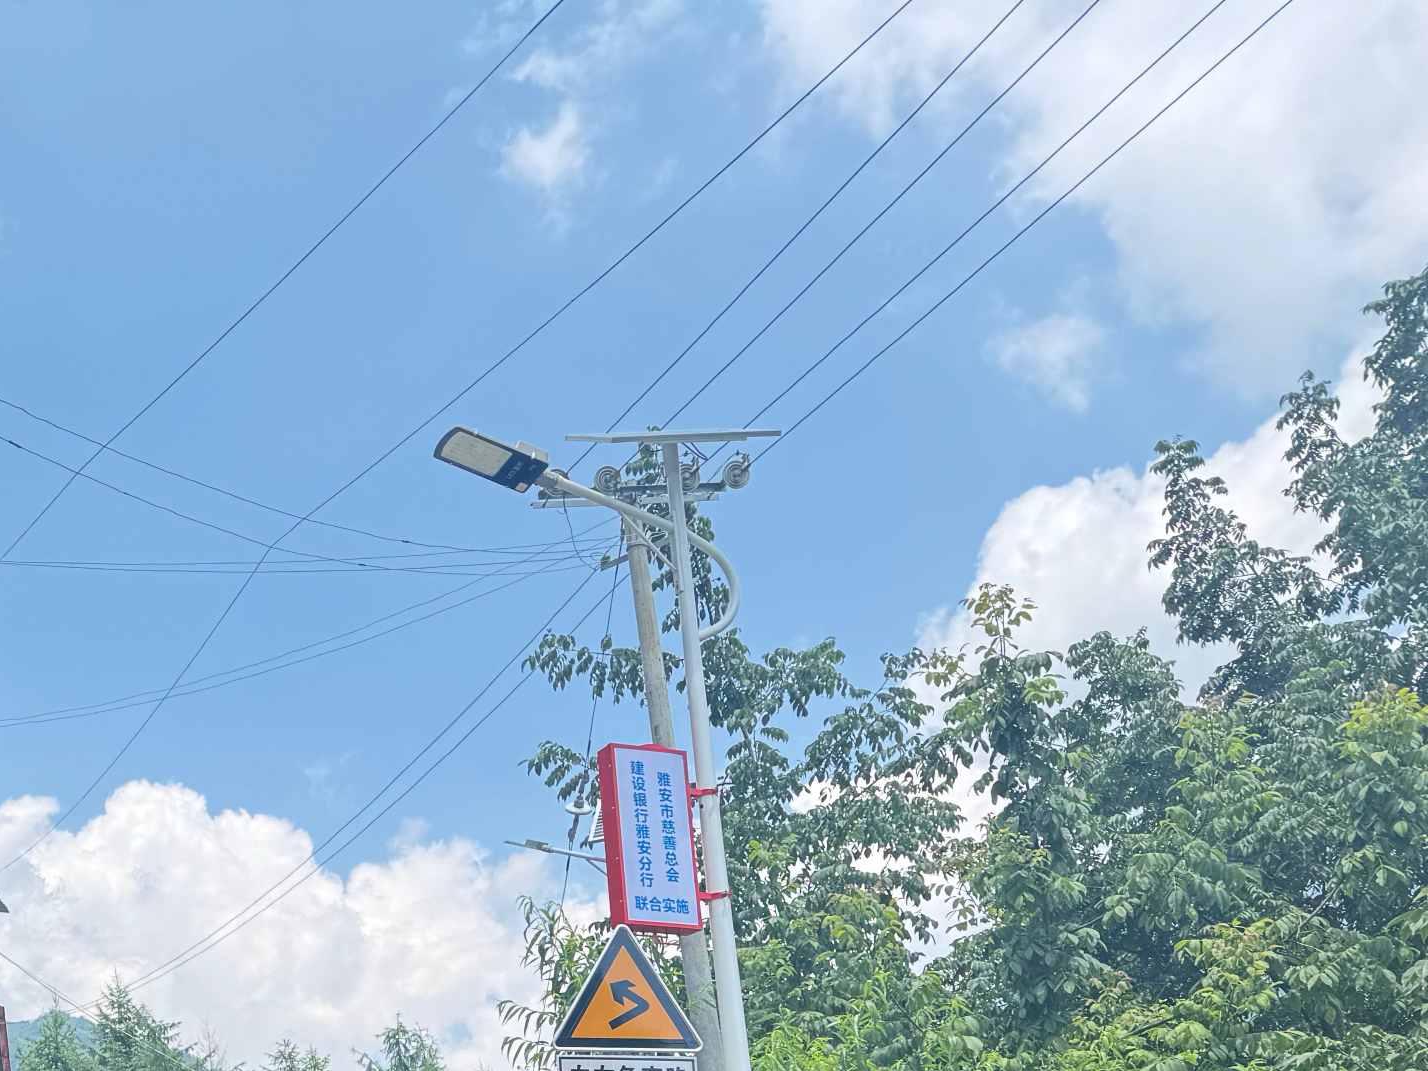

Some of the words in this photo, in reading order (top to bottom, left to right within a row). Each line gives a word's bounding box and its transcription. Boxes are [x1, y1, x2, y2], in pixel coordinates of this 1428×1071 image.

[630, 760, 654, 888] 建设银行雅安分行
[657, 772, 680, 883] 雅安市慈善总会
[634, 896, 689, 914] 联合实施
